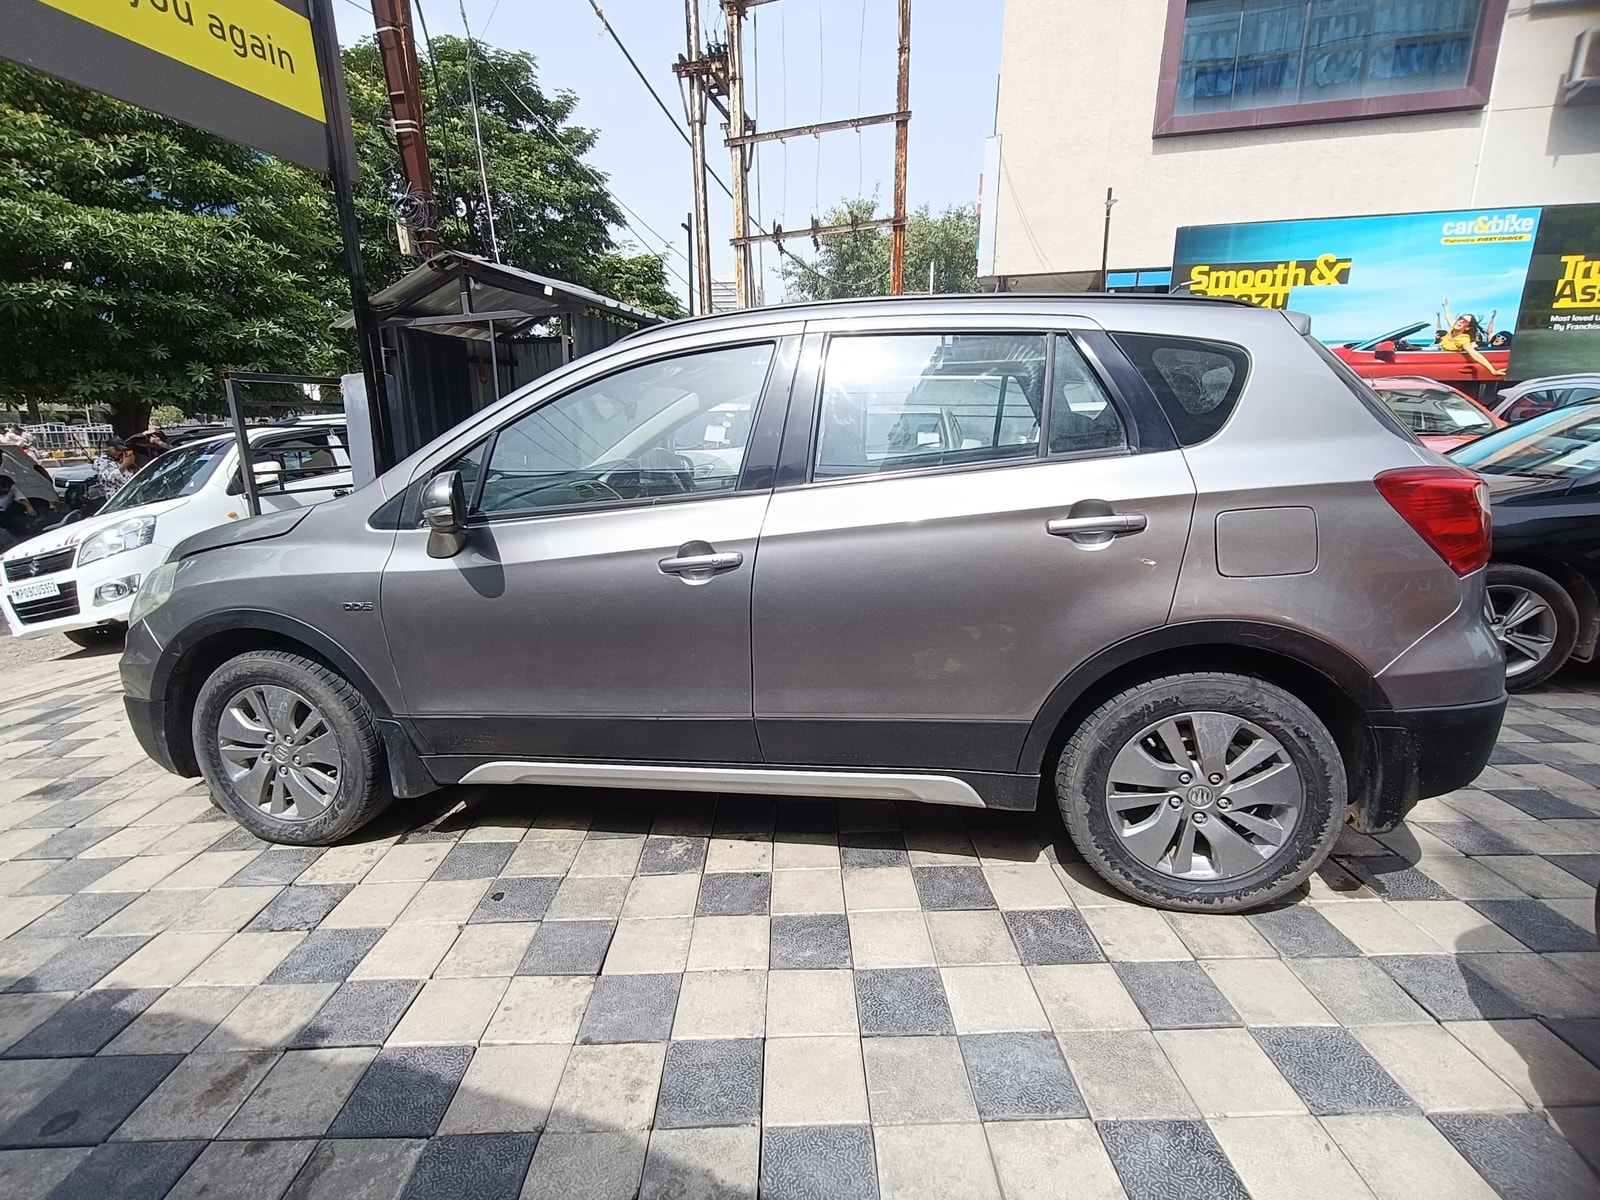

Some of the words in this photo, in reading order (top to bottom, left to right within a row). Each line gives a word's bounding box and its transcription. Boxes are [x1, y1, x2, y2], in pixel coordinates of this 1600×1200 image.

[207, 13, 295, 75] again
[1190, 260, 1306, 292] Smooth
[1310, 253, 1352, 287] &
[1553, 323, 1565, 331] By
[1572, 314, 1594, 322] loved
